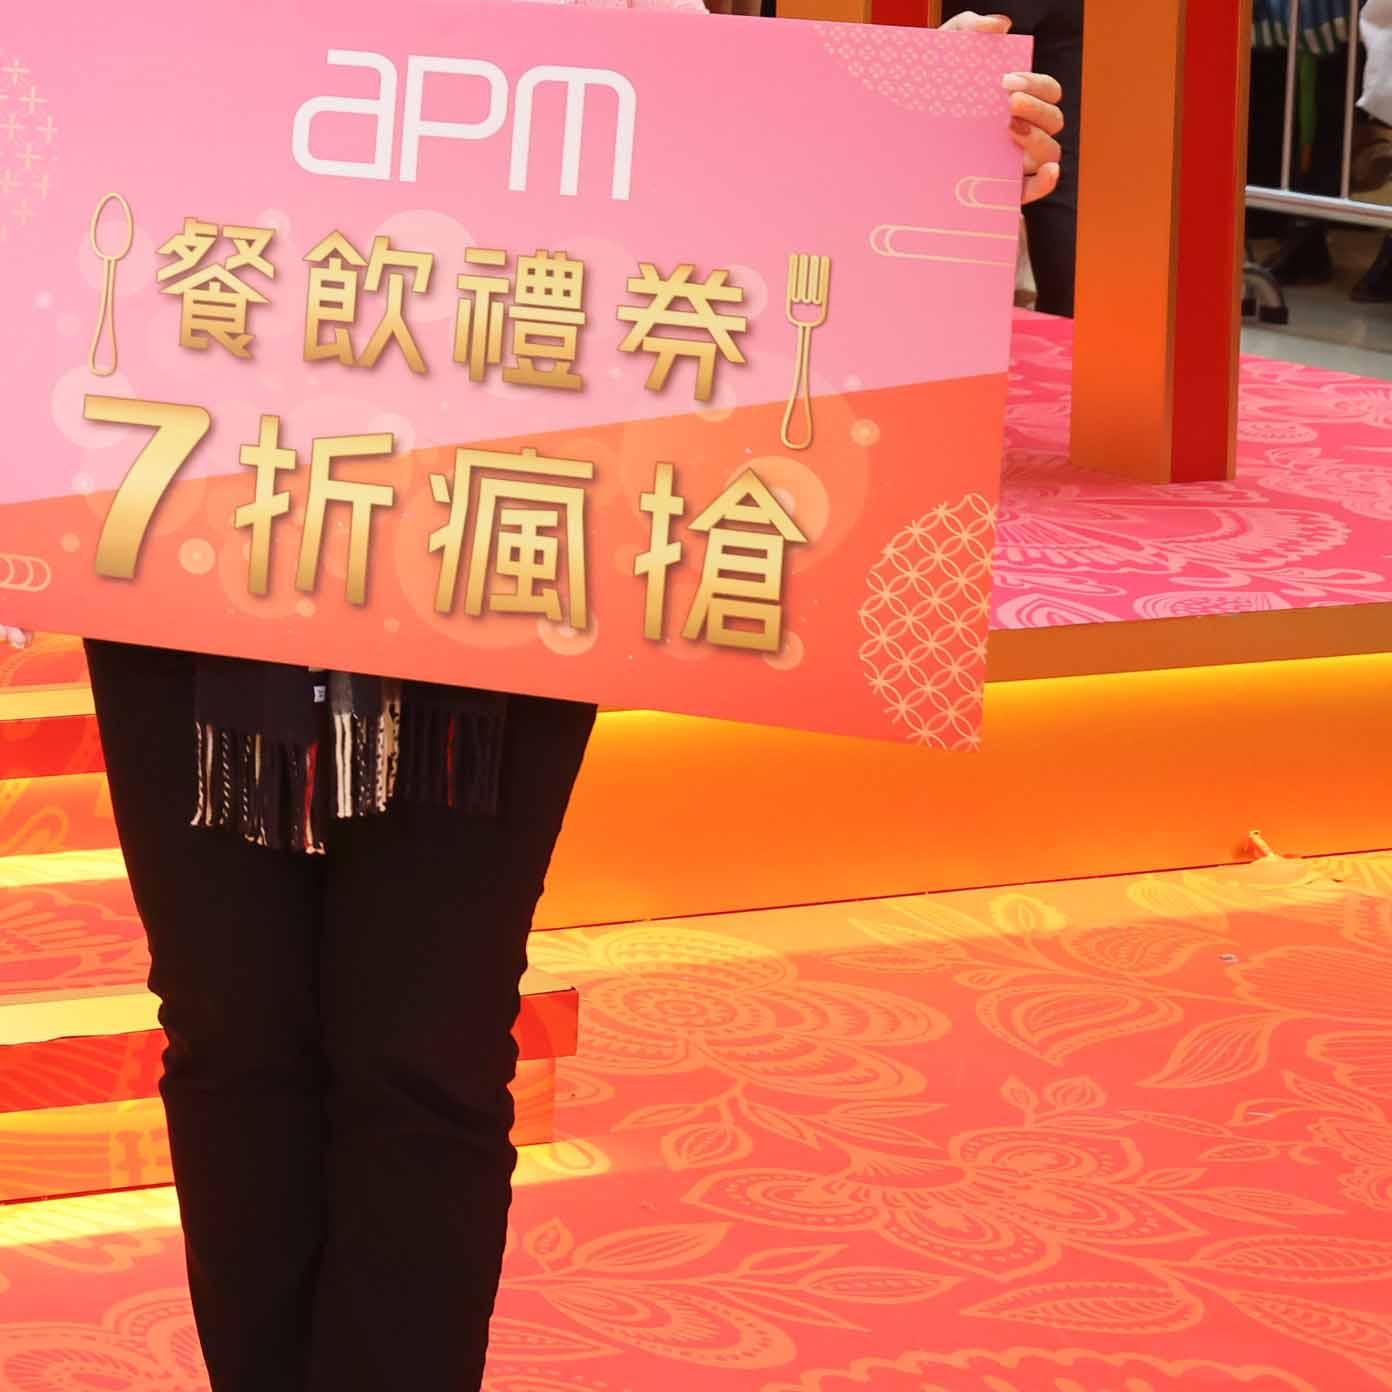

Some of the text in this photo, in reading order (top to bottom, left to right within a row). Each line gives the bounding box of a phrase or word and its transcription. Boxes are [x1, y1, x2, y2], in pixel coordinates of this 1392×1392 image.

[155, 216, 750, 404] 餐飲禮券
[81, 394, 809, 654] 7折瘋搶
